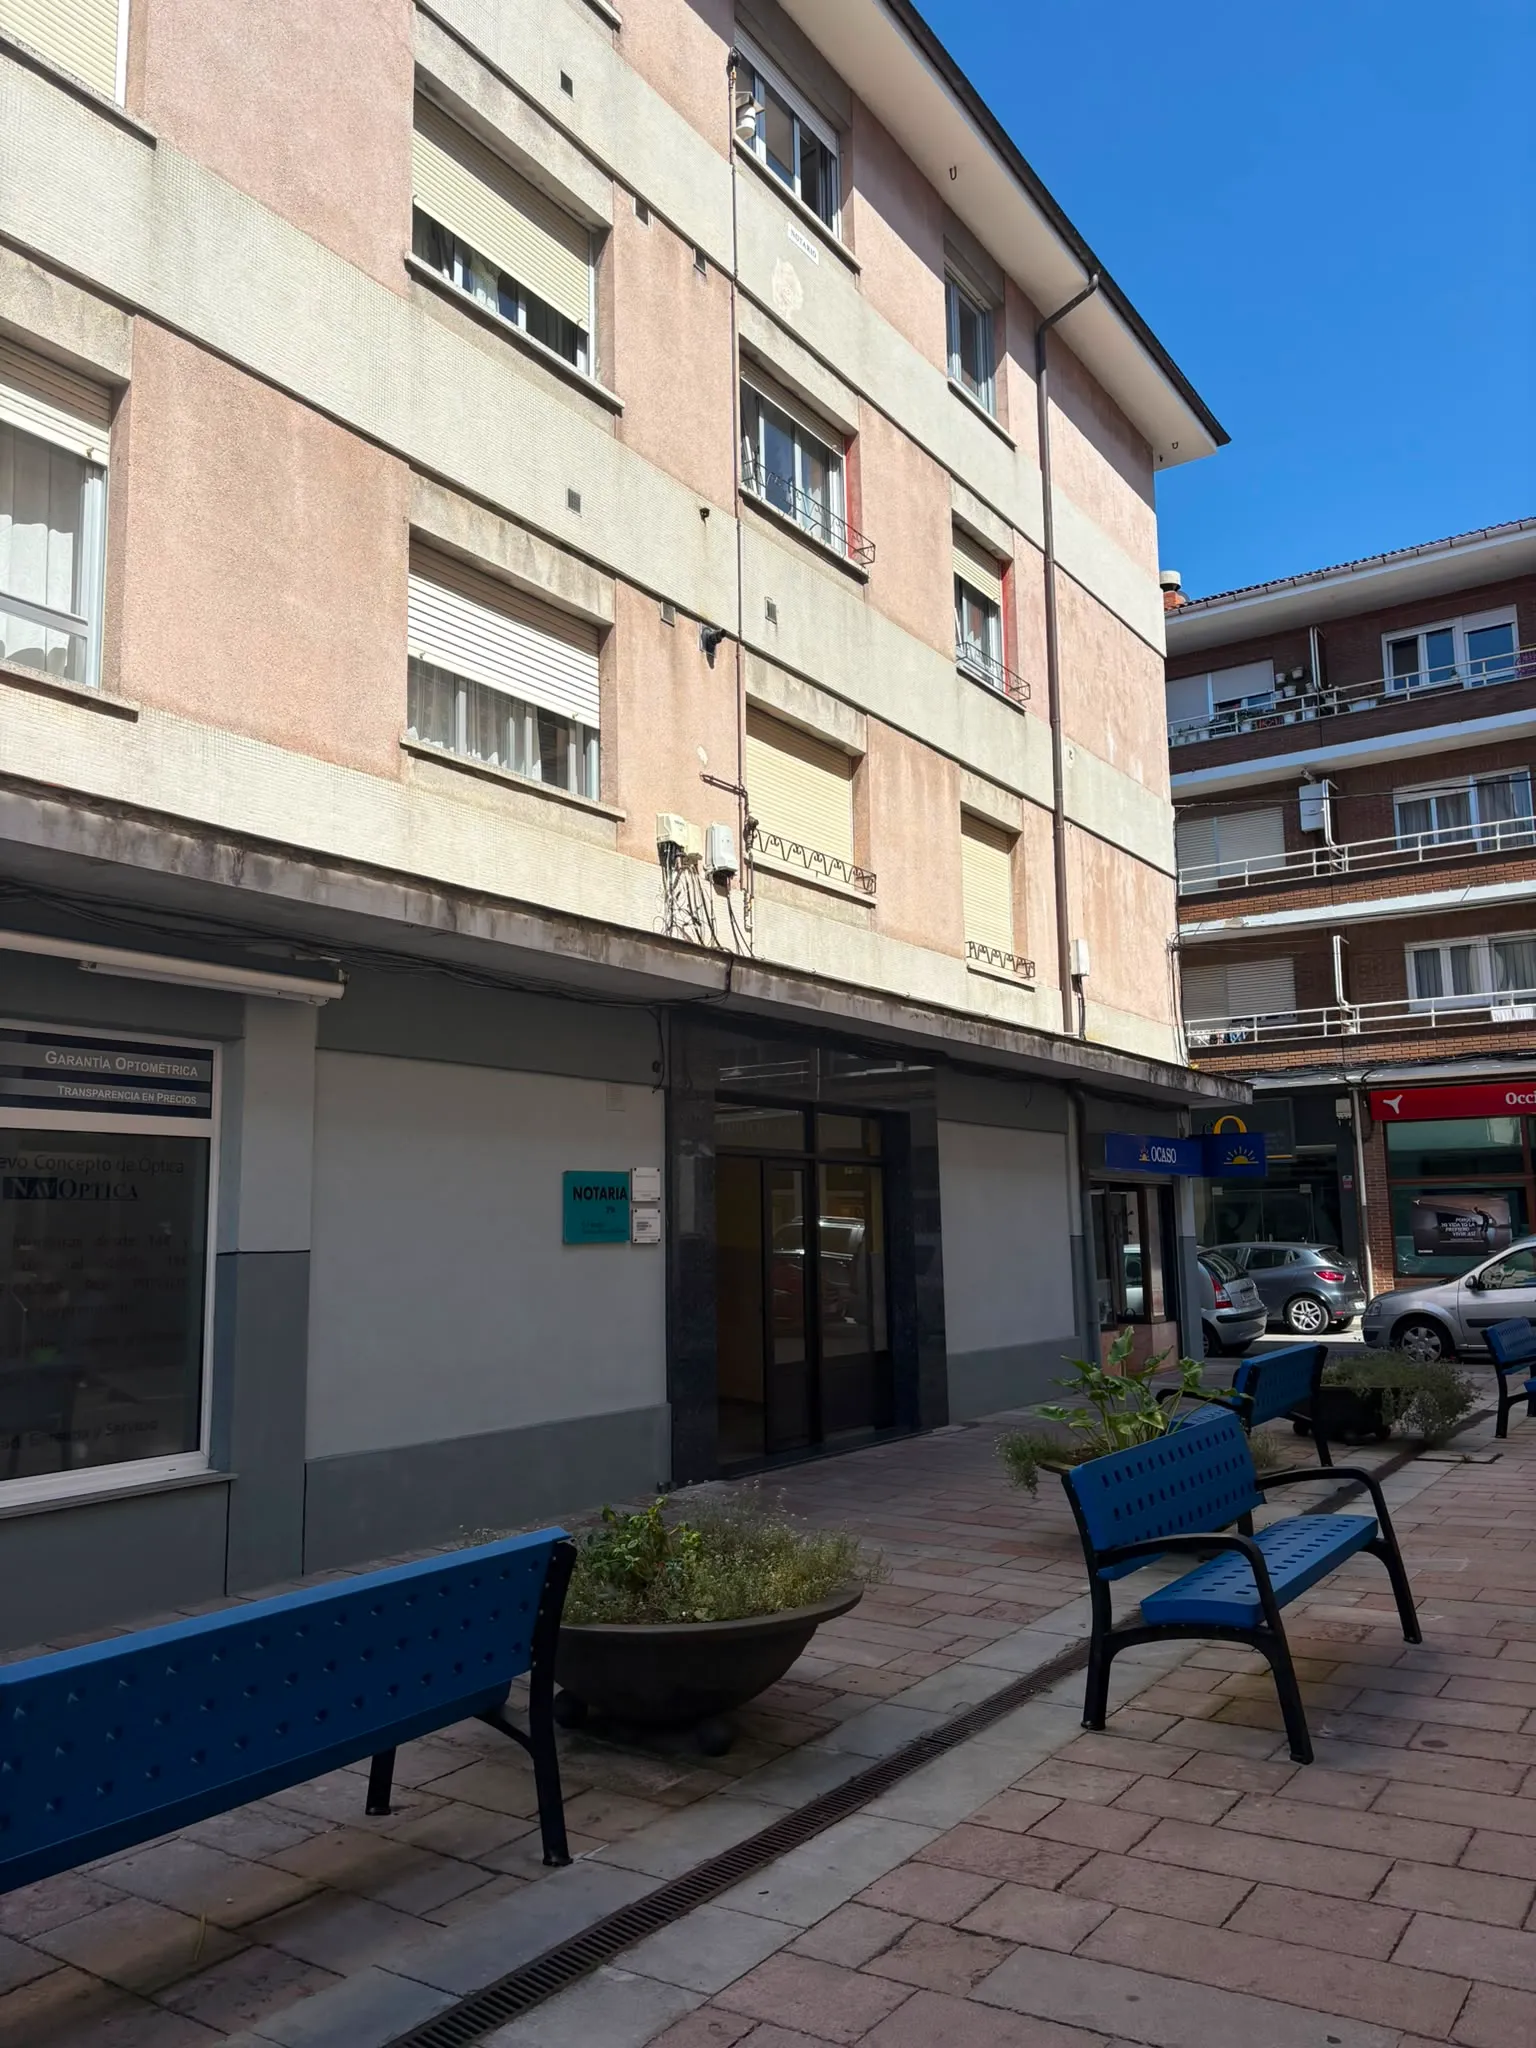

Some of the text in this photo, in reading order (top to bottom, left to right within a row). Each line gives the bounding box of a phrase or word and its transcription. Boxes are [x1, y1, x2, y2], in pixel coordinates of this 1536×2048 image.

[790, 228, 817, 258] NOTARIO
[45, 1050, 198, 1077] GARANTÍA OPTOMÉTRICA
[58, 1085, 197, 1105] TRANSPARENCIA EN PRECIOS
[34, 1154, 112, 1175] Concepto
[116, 1156, 135, 1172] de
[1151, 1146, 1177, 1163] OCASO
[572, 1186, 628, 1201] NOTARIA
